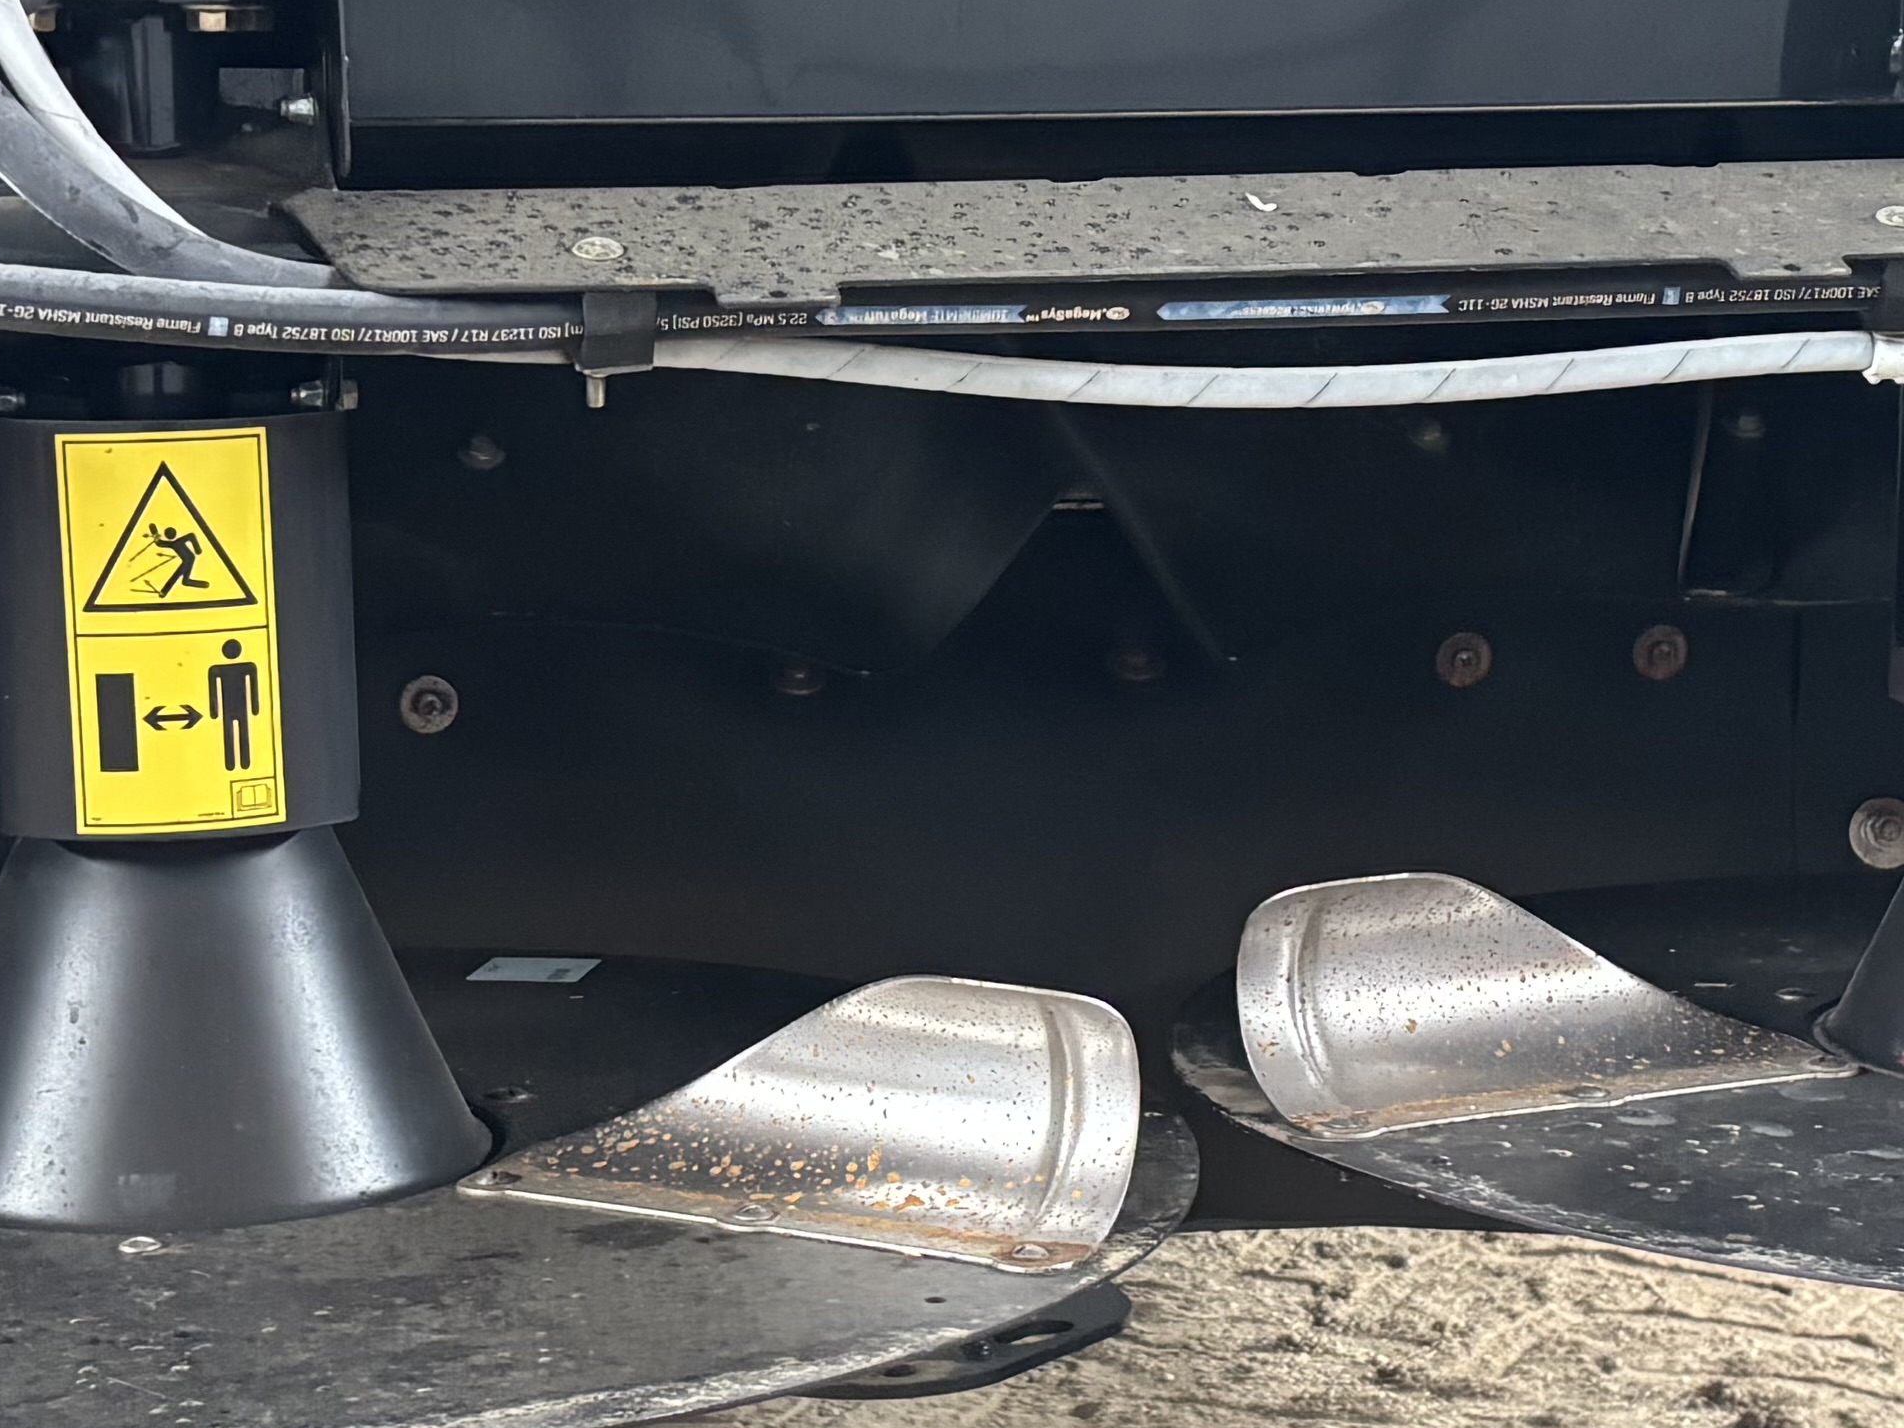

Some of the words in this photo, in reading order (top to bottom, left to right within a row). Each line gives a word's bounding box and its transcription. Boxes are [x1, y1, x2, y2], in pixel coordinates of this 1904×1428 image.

[1552, 293, 1614, 309] Resistant
[1615, 291, 1656, 306] Flame
[1697, 288, 1726, 303] Type
[1729, 288, 1771, 303] 18752
[1774, 286, 1796, 301] ISO
[1511, 296, 1549, 311] MSHA
[37, 307, 82, 324] MSHA
[84, 311, 154, 330] Resistant
[746, 312, 775, 327] MPa
[777, 312, 808, 327] 22.5
[156, 317, 201, 334] Flame
[234, 323, 245, 337] B
[247, 323, 279, 340] Type
[538, 324, 562, 339] ISO
[282, 325, 329, 342] 18752
[331, 327, 355, 342] ISO
[422, 328, 449, 343] SAE
[460, 328, 488, 343] R17
[492, 326, 534, 342] 11237
